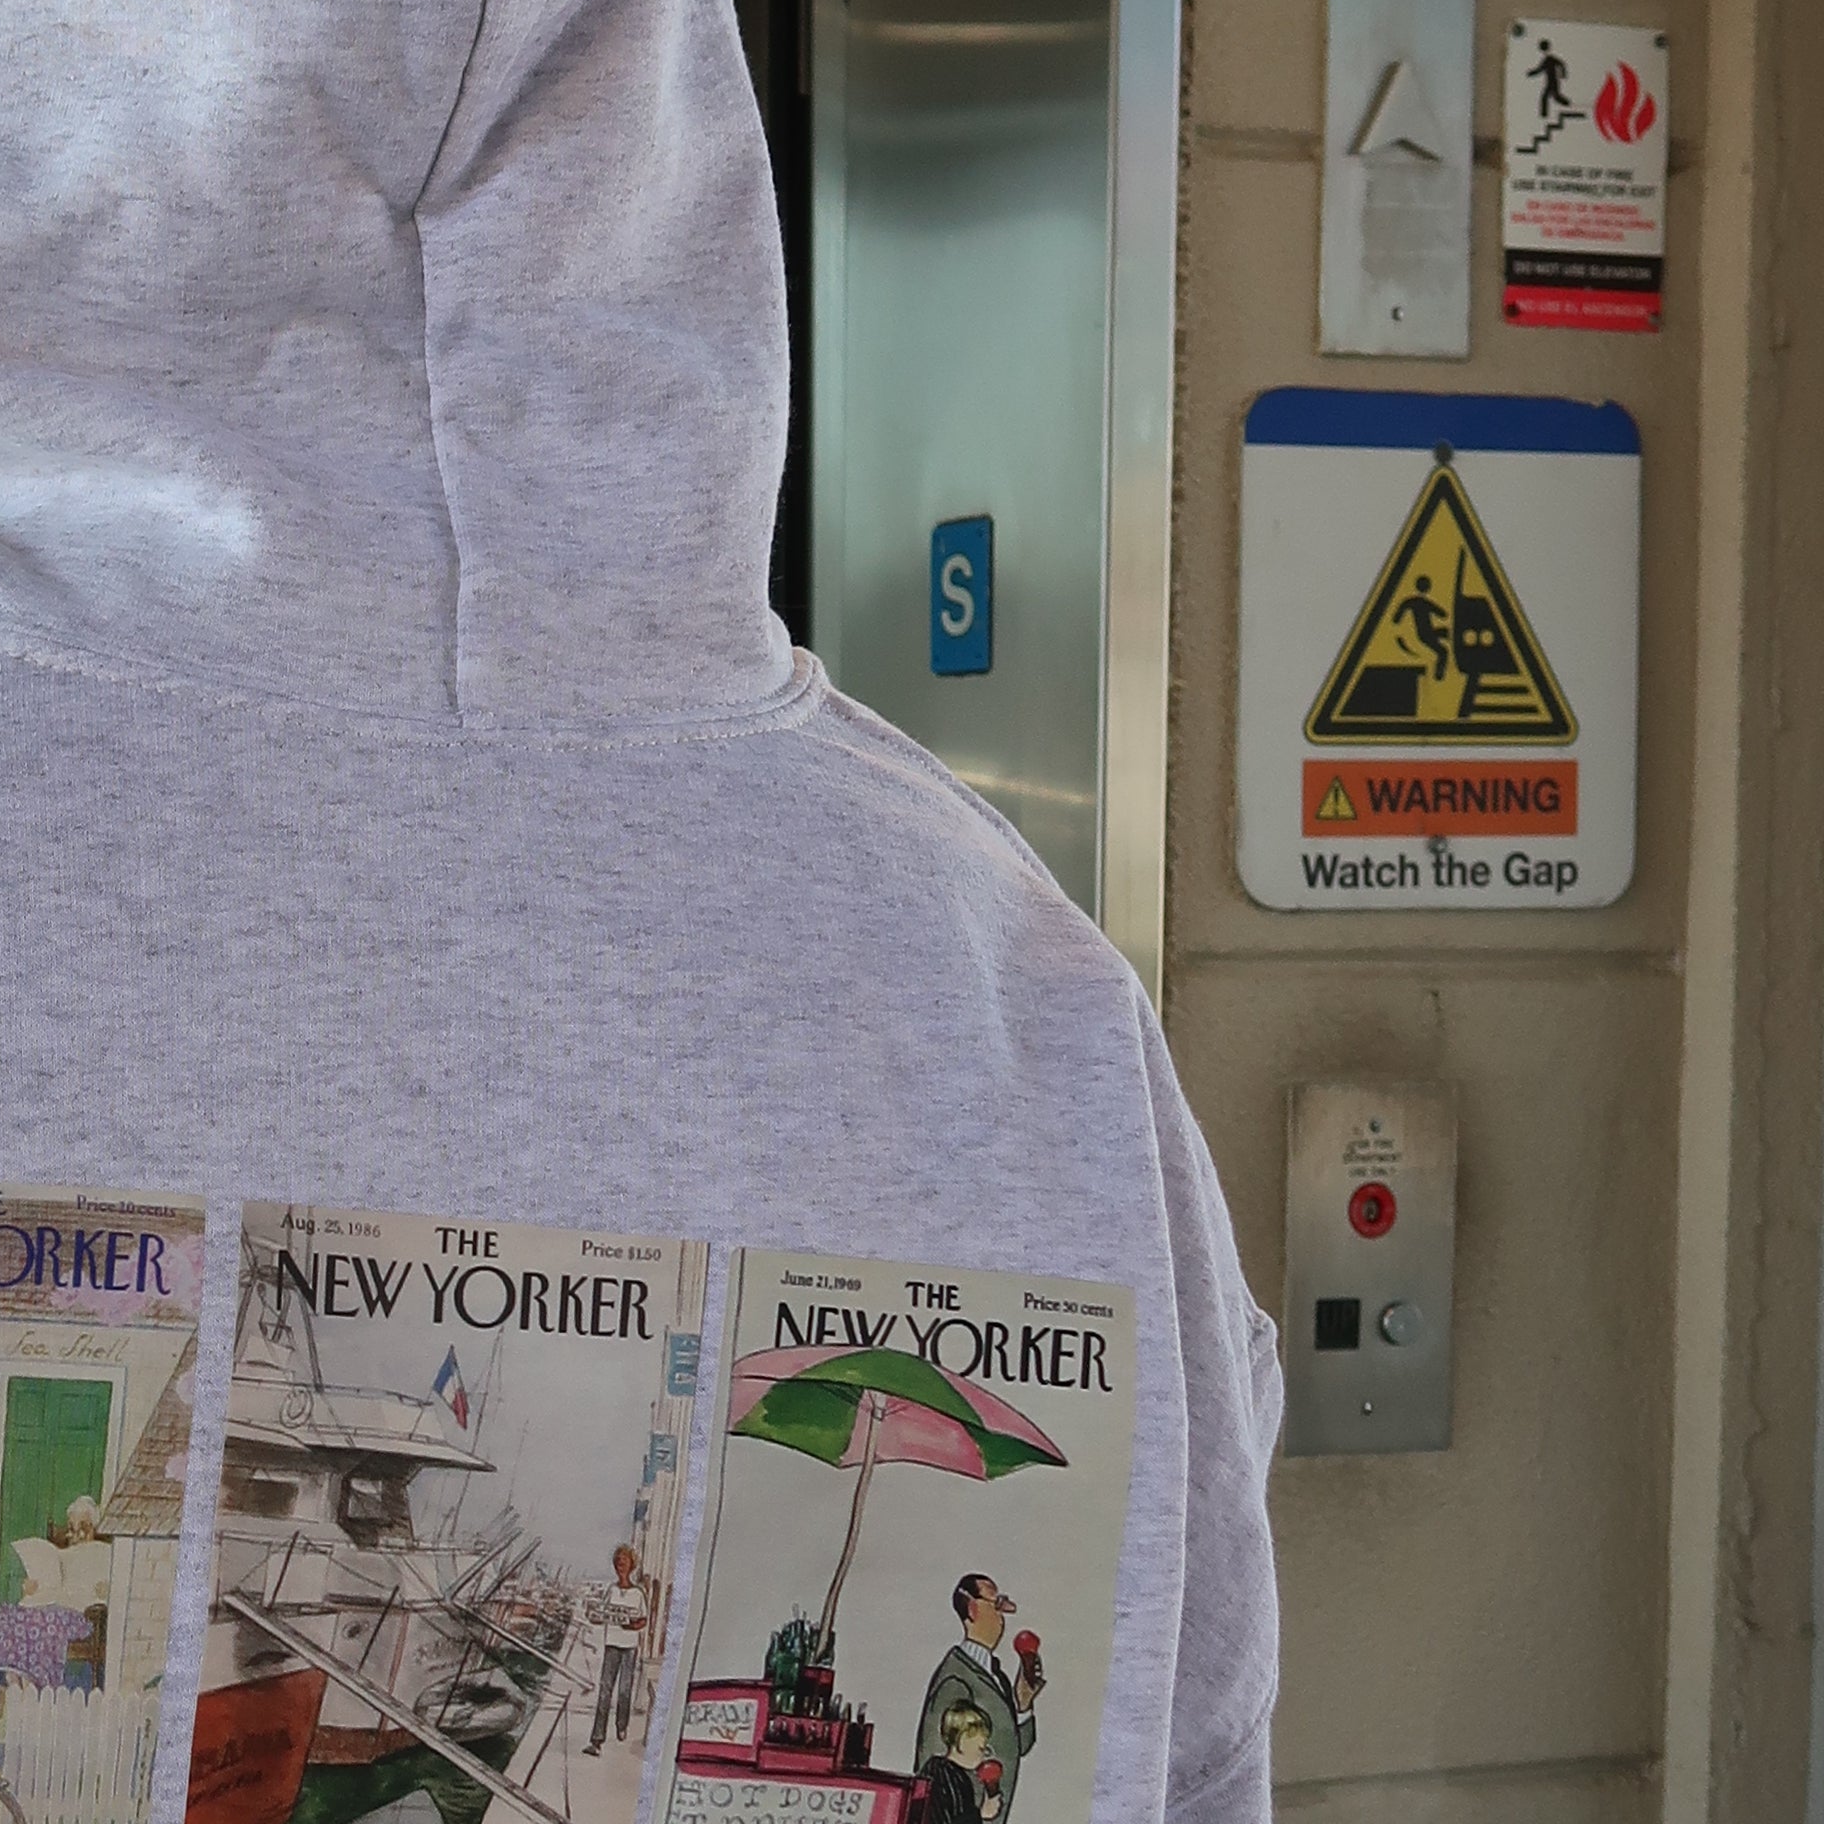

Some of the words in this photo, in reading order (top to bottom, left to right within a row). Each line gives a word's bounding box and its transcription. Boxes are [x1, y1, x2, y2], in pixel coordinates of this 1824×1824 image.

[941, 553, 974, 637] S
[1366, 778, 1561, 816] WARNING
[1302, 853, 1419, 889] Watch
[1434, 854, 1490, 888] the
[1503, 851, 1579, 894] Gap
[77, 1194, 116, 1213] Price
[280, 1212, 320, 1236] Aug.
[348, 1222, 382, 1238] 1986
[434, 1227, 499, 1258] THE
[581, 1240, 623, 1259] Price
[780, 1270, 814, 1287] June
[276, 1250, 412, 1319] NEW
[422, 1264, 654, 1341] YORKER
[904, 1281, 961, 1312] THE
[1024, 1292, 1060, 1311] Price
[1081, 1303, 1114, 1318] cents
[774, 1301, 897, 1348] NEW
[905, 1313, 1114, 1393] YORKER
[780, 1787, 862, 1815] DOGS
